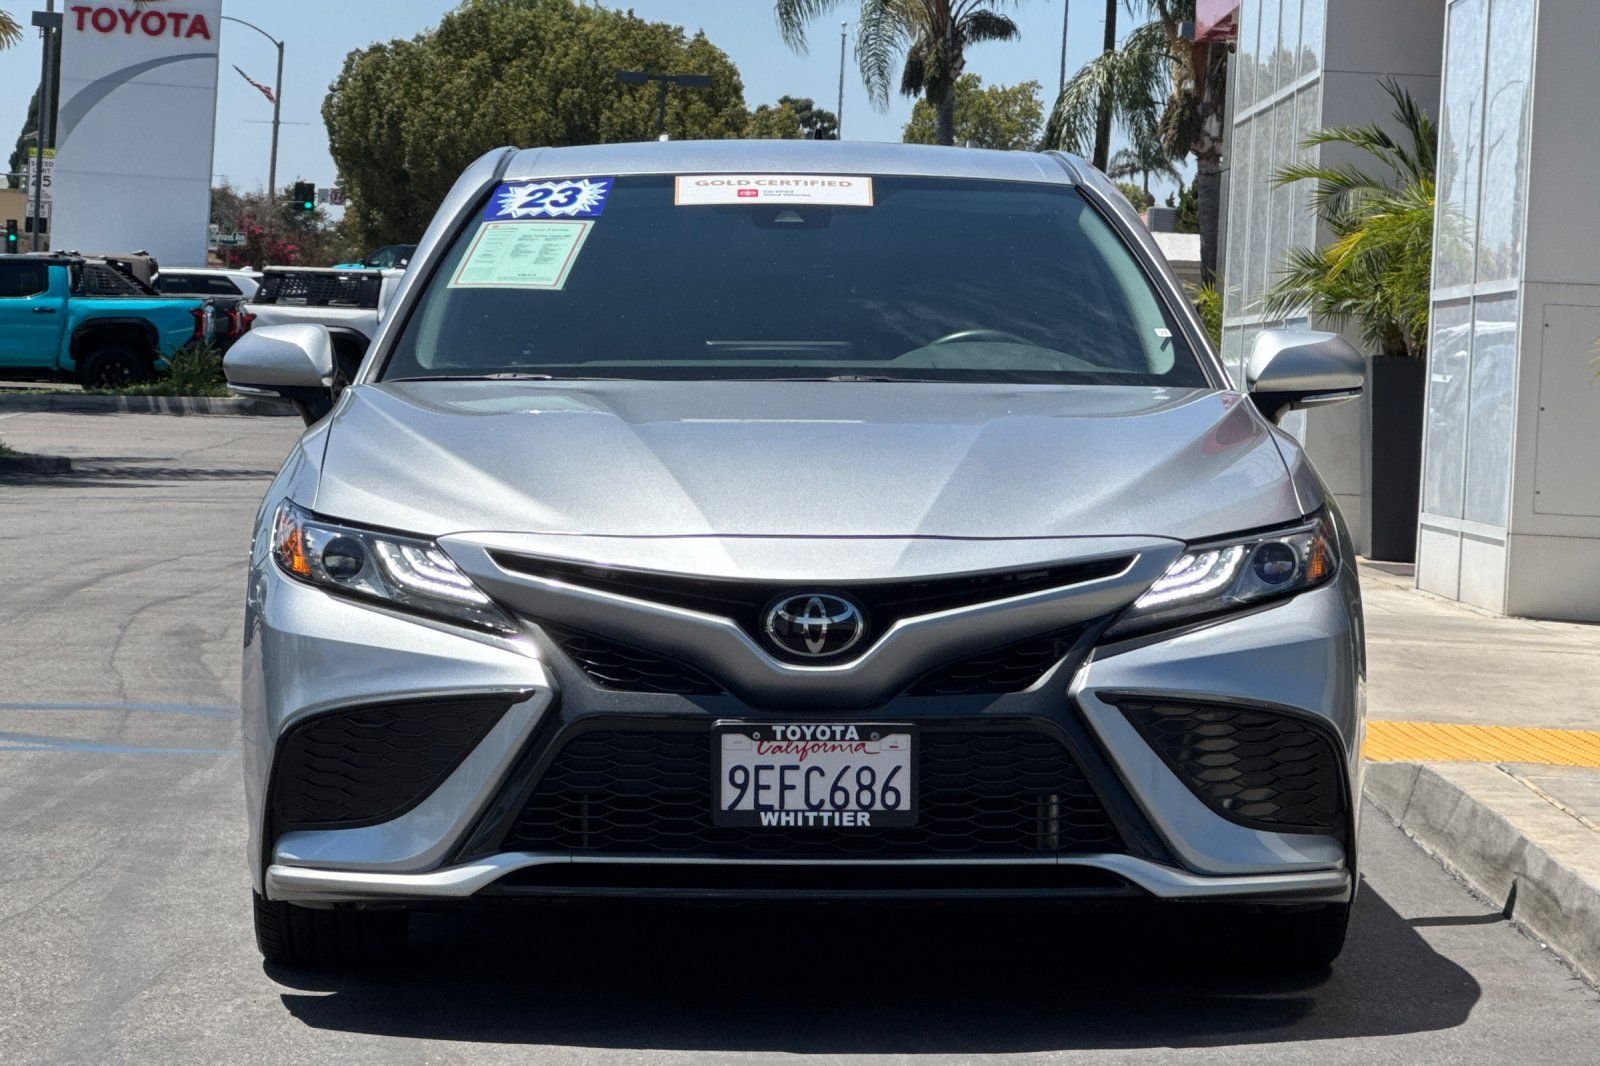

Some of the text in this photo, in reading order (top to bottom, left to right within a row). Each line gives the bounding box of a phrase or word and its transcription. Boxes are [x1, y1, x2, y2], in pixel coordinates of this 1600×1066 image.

[70, 5, 211, 40] TOYOTA
[695, 178, 853, 188] GOLD CERTIFIED
[517, 186, 582, 209] 23
[771, 725, 859, 741] TOYOTA
[756, 740, 880, 762] California
[728, 764, 902, 810] 9EFC686
[760, 811, 871, 826] WHITTIER
